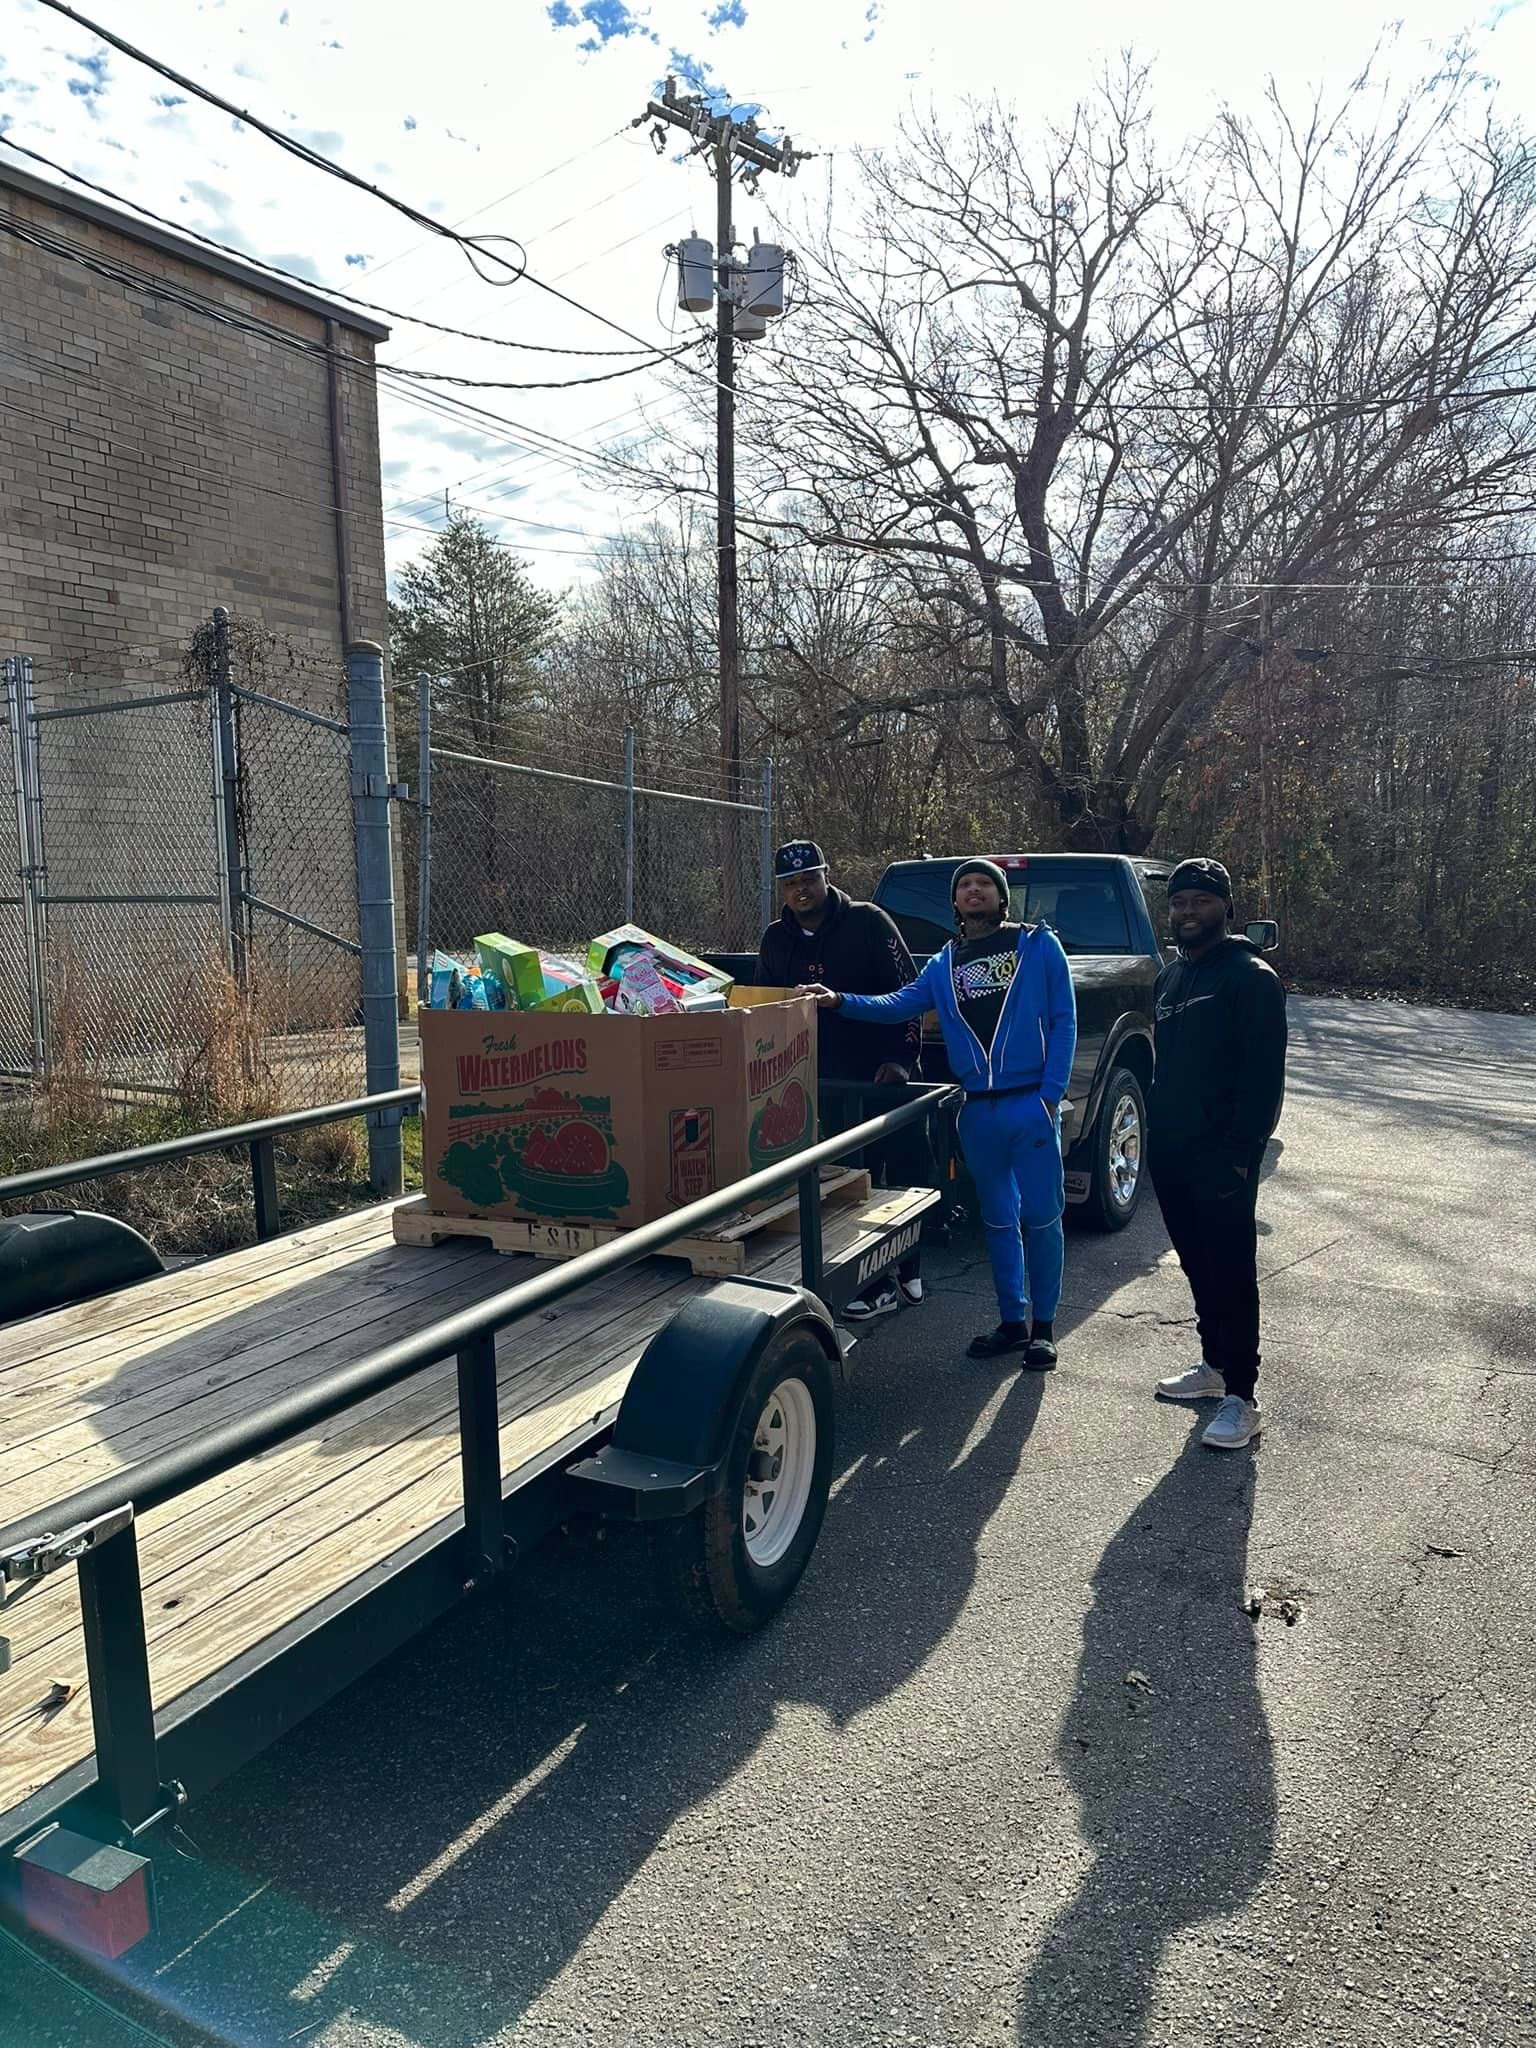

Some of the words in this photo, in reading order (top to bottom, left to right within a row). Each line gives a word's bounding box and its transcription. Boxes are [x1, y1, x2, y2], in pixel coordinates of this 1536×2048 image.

[482, 1033, 517, 1055] Fresh
[749, 1029, 810, 1097] WATERMELONS
[457, 1038, 588, 1093] WATERMELONS
[681, 1157, 706, 1177] WATCH
[684, 1177, 704, 1197] STEP
[857, 1220, 922, 1285] KARAVAN
